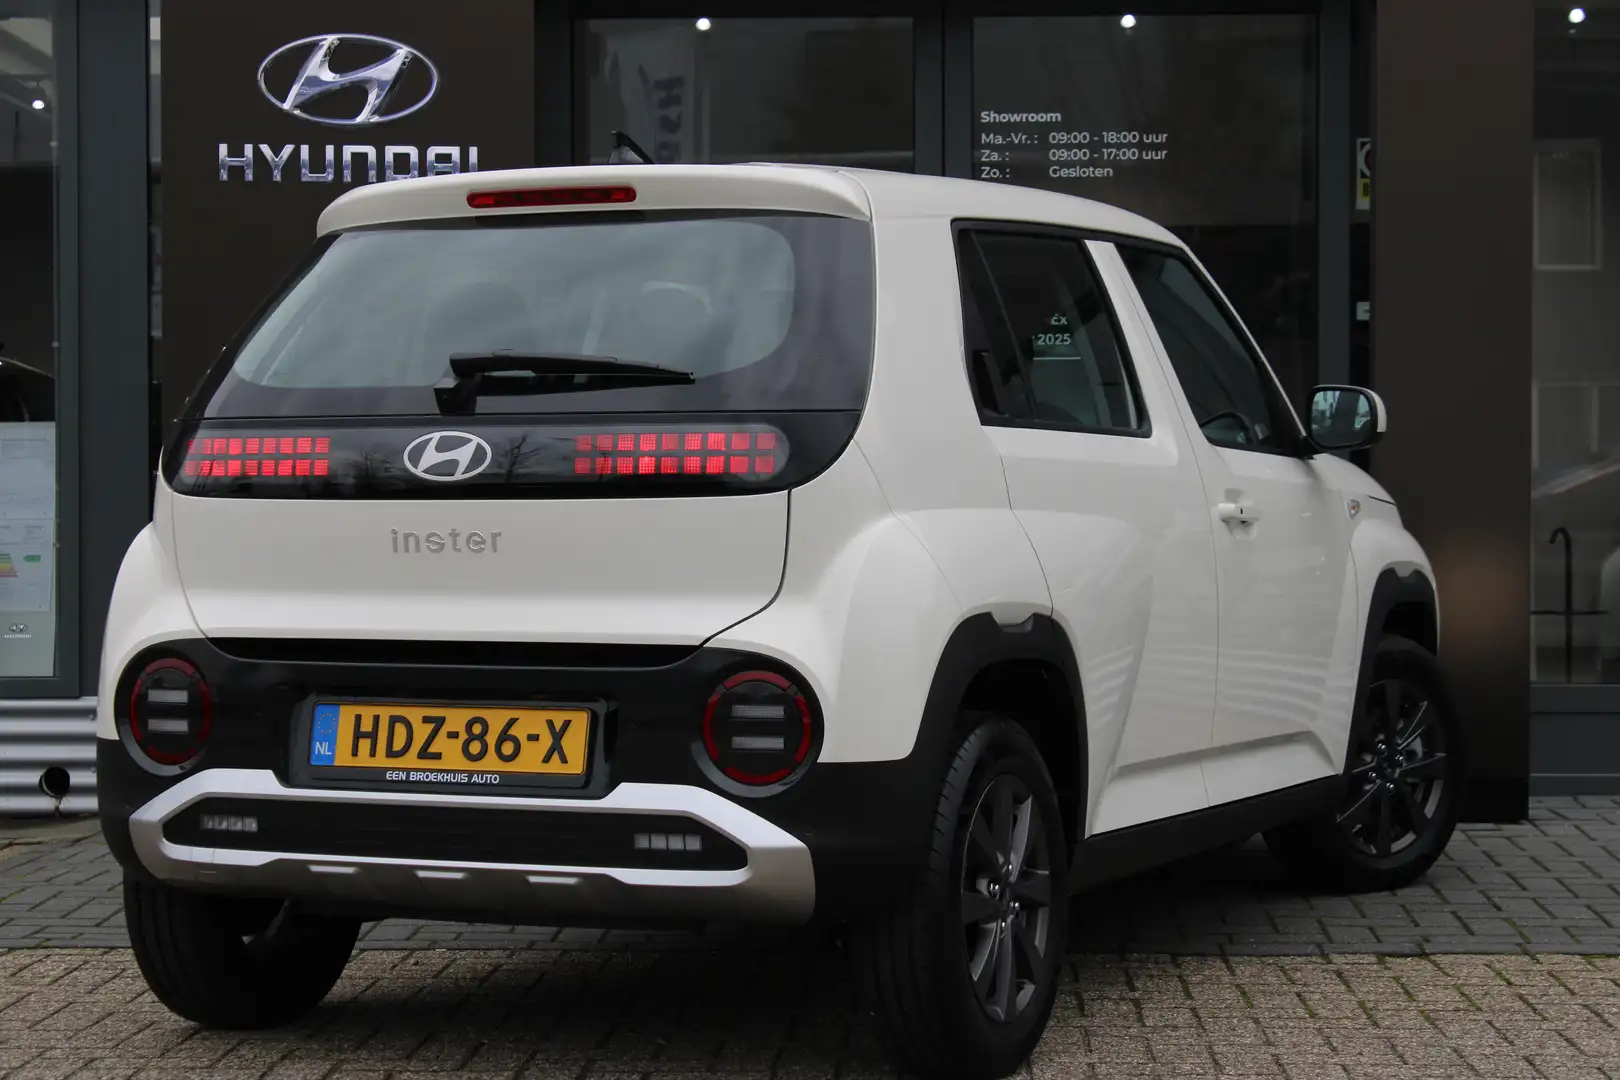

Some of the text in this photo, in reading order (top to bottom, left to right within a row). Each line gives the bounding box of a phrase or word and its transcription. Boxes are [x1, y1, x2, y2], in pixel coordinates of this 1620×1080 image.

[980, 110, 1062, 123] Showroom
[1048, 131, 1090, 144] 09:00
[1102, 131, 1139, 144] 18:00
[1143, 133, 1168, 143] uur
[1048, 149, 1090, 161] 09:00
[1102, 148, 1139, 160] 17:00
[1143, 150, 1168, 160] uur
[218, 143, 478, 183] HYUNDAI
[1049, 165, 1113, 178] Gesloten
[1037, 333, 1071, 345] 2025
[390, 528, 502, 554] inster
[351, 713, 572, 764] HDZ-86-X
[315, 741, 333, 756] NL
[386, 770, 500, 784] EEN BROEKHUIS AUTO
